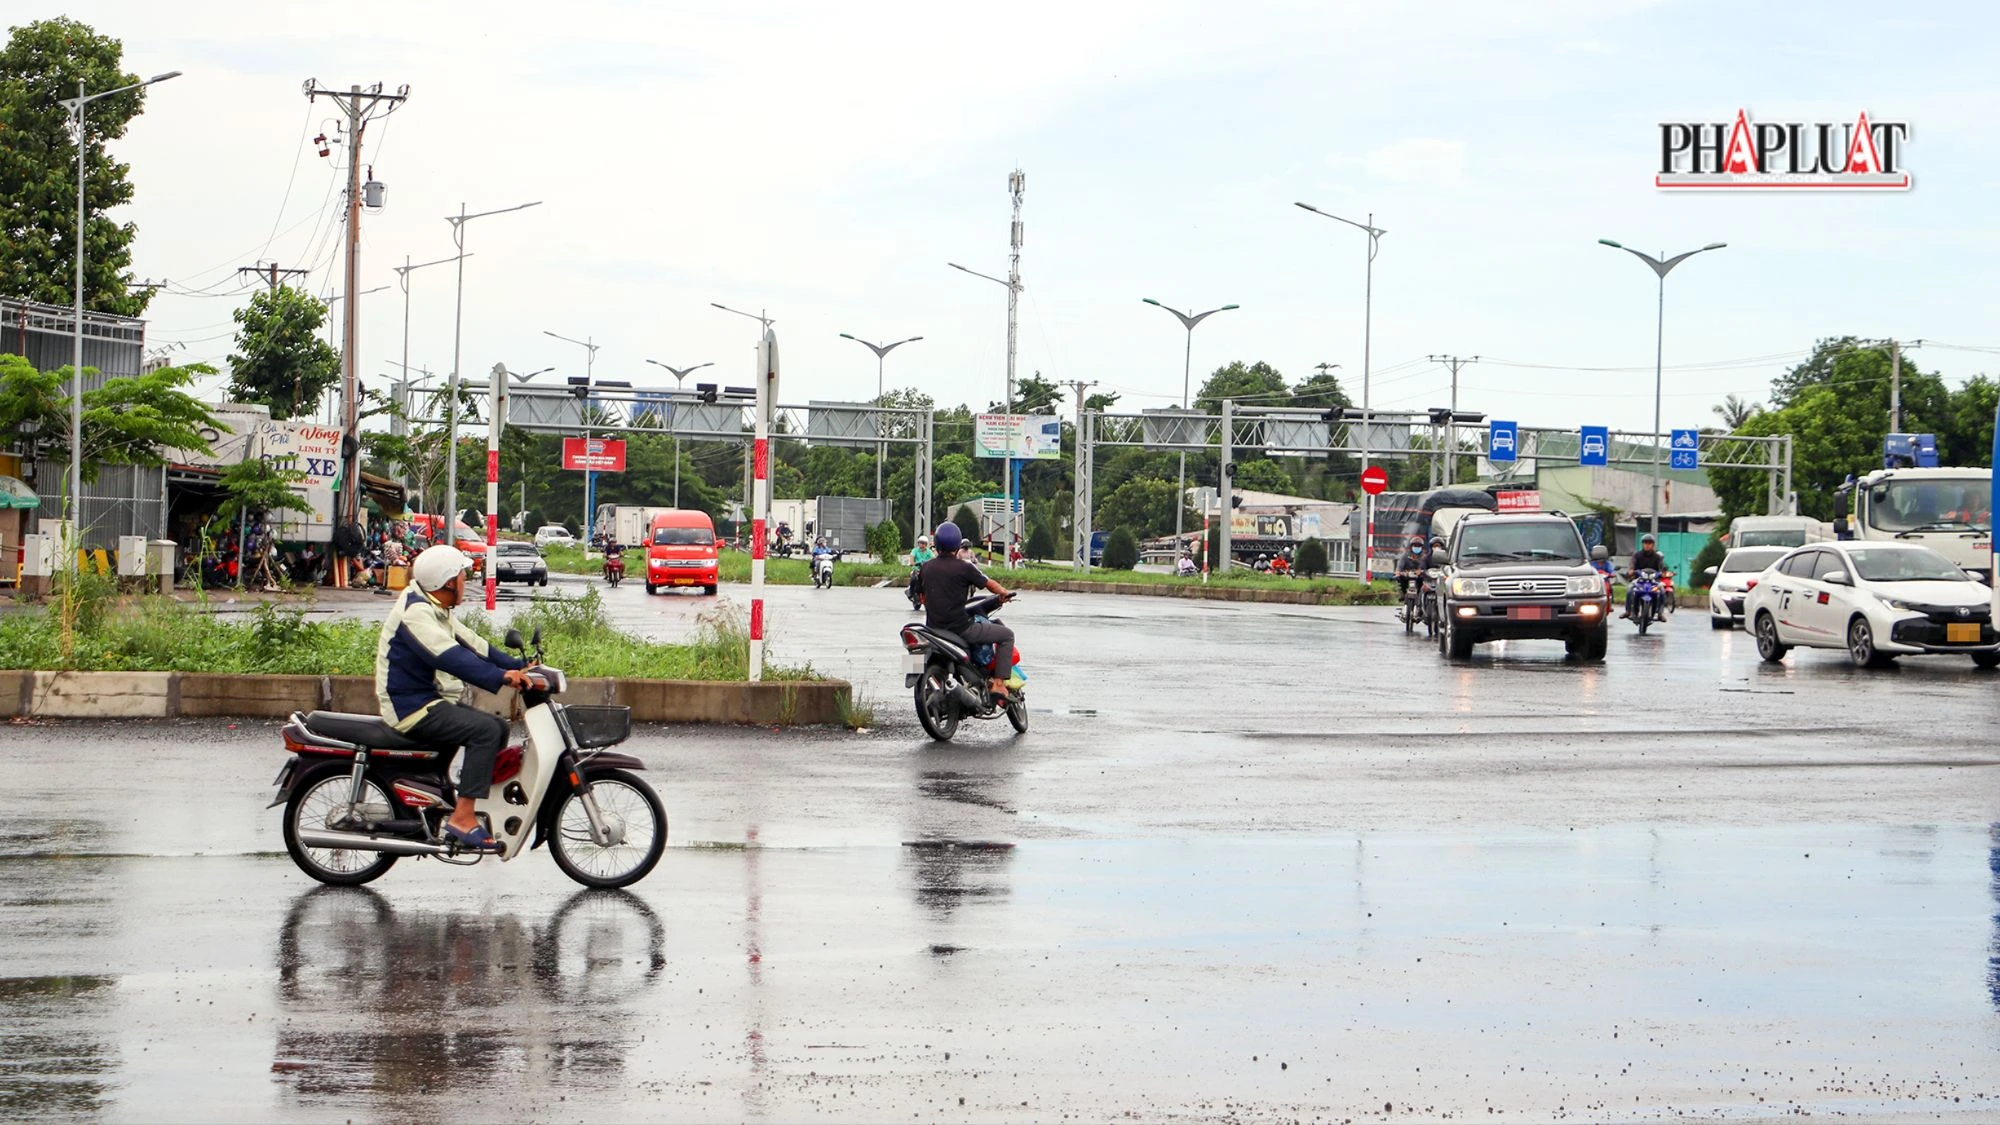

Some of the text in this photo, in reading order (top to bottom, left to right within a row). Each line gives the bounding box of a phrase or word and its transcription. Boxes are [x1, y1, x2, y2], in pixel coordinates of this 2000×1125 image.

[300, 426, 340, 445] Võng
[299, 445, 321, 454] LINH
[306, 457, 336, 476] XE
